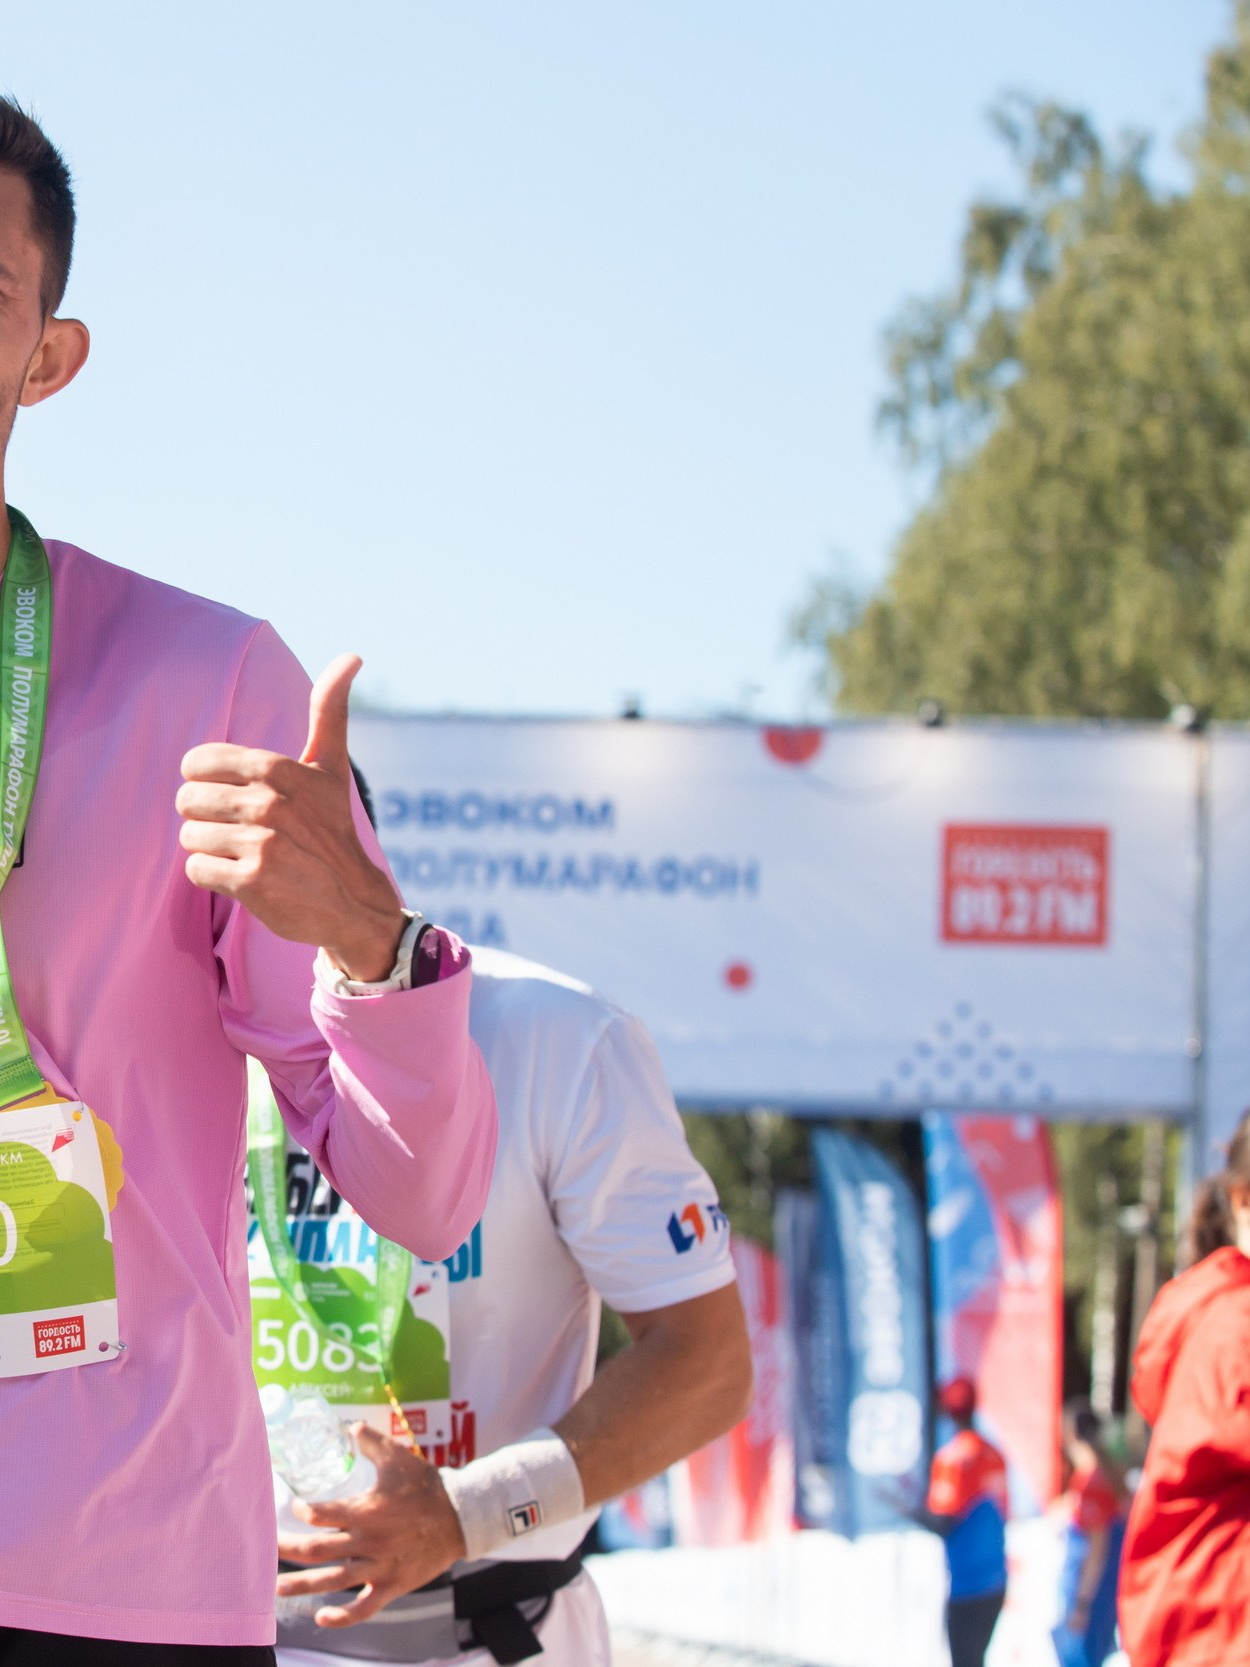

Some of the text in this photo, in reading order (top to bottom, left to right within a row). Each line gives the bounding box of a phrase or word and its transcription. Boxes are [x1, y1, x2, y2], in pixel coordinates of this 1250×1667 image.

[14, 587, 37, 658] ЭВОКОМ
[6, 665, 33, 816] ПОЛУМАРАФОН
[381, 791, 616, 831] ЭВОКОМ
[38, 1324, 81, 1339] ГОРДОСТЬ
[39, 1334, 81, 1353] 89.2 FM
